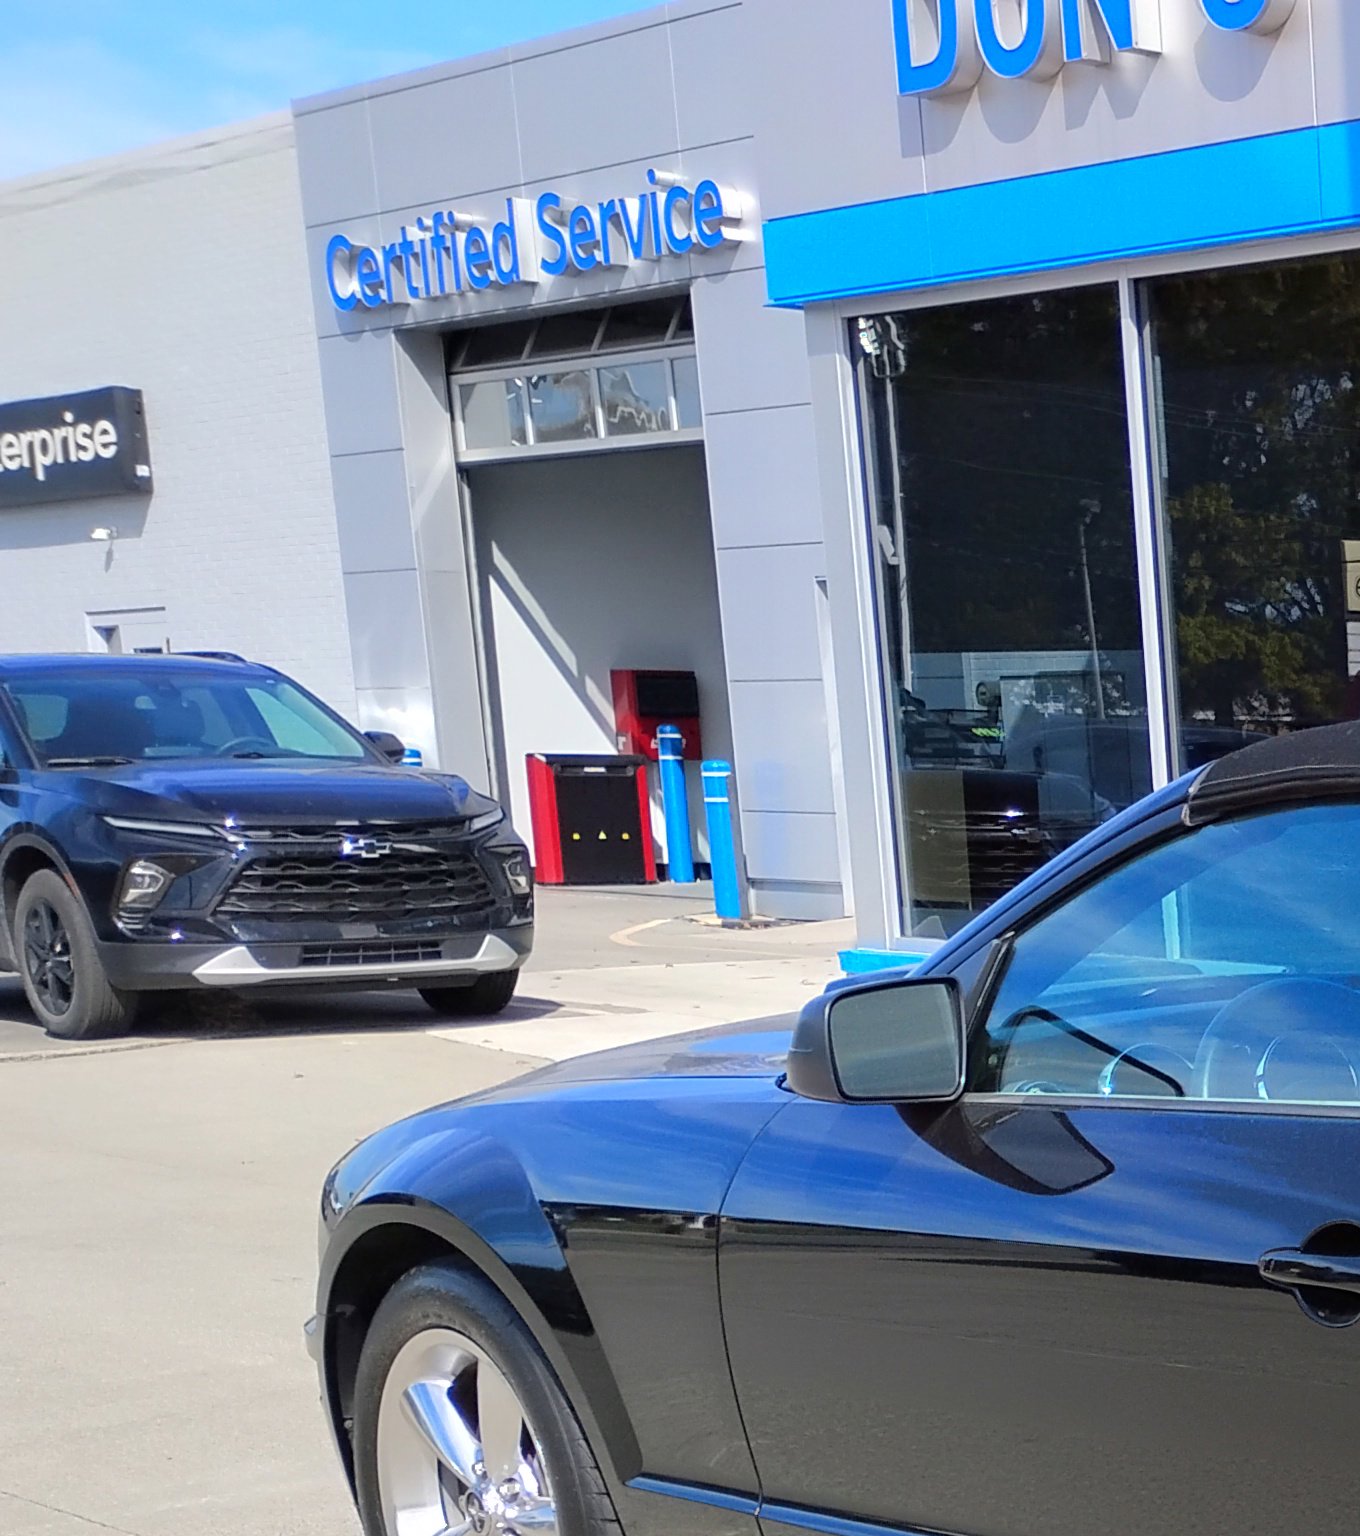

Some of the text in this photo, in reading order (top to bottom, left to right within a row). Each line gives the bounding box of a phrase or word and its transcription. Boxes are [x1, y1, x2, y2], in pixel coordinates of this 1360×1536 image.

[892, 0, 1266, 95] DON
[325, 168, 724, 313] Certified Service
[0, 411, 119, 481] erprise
